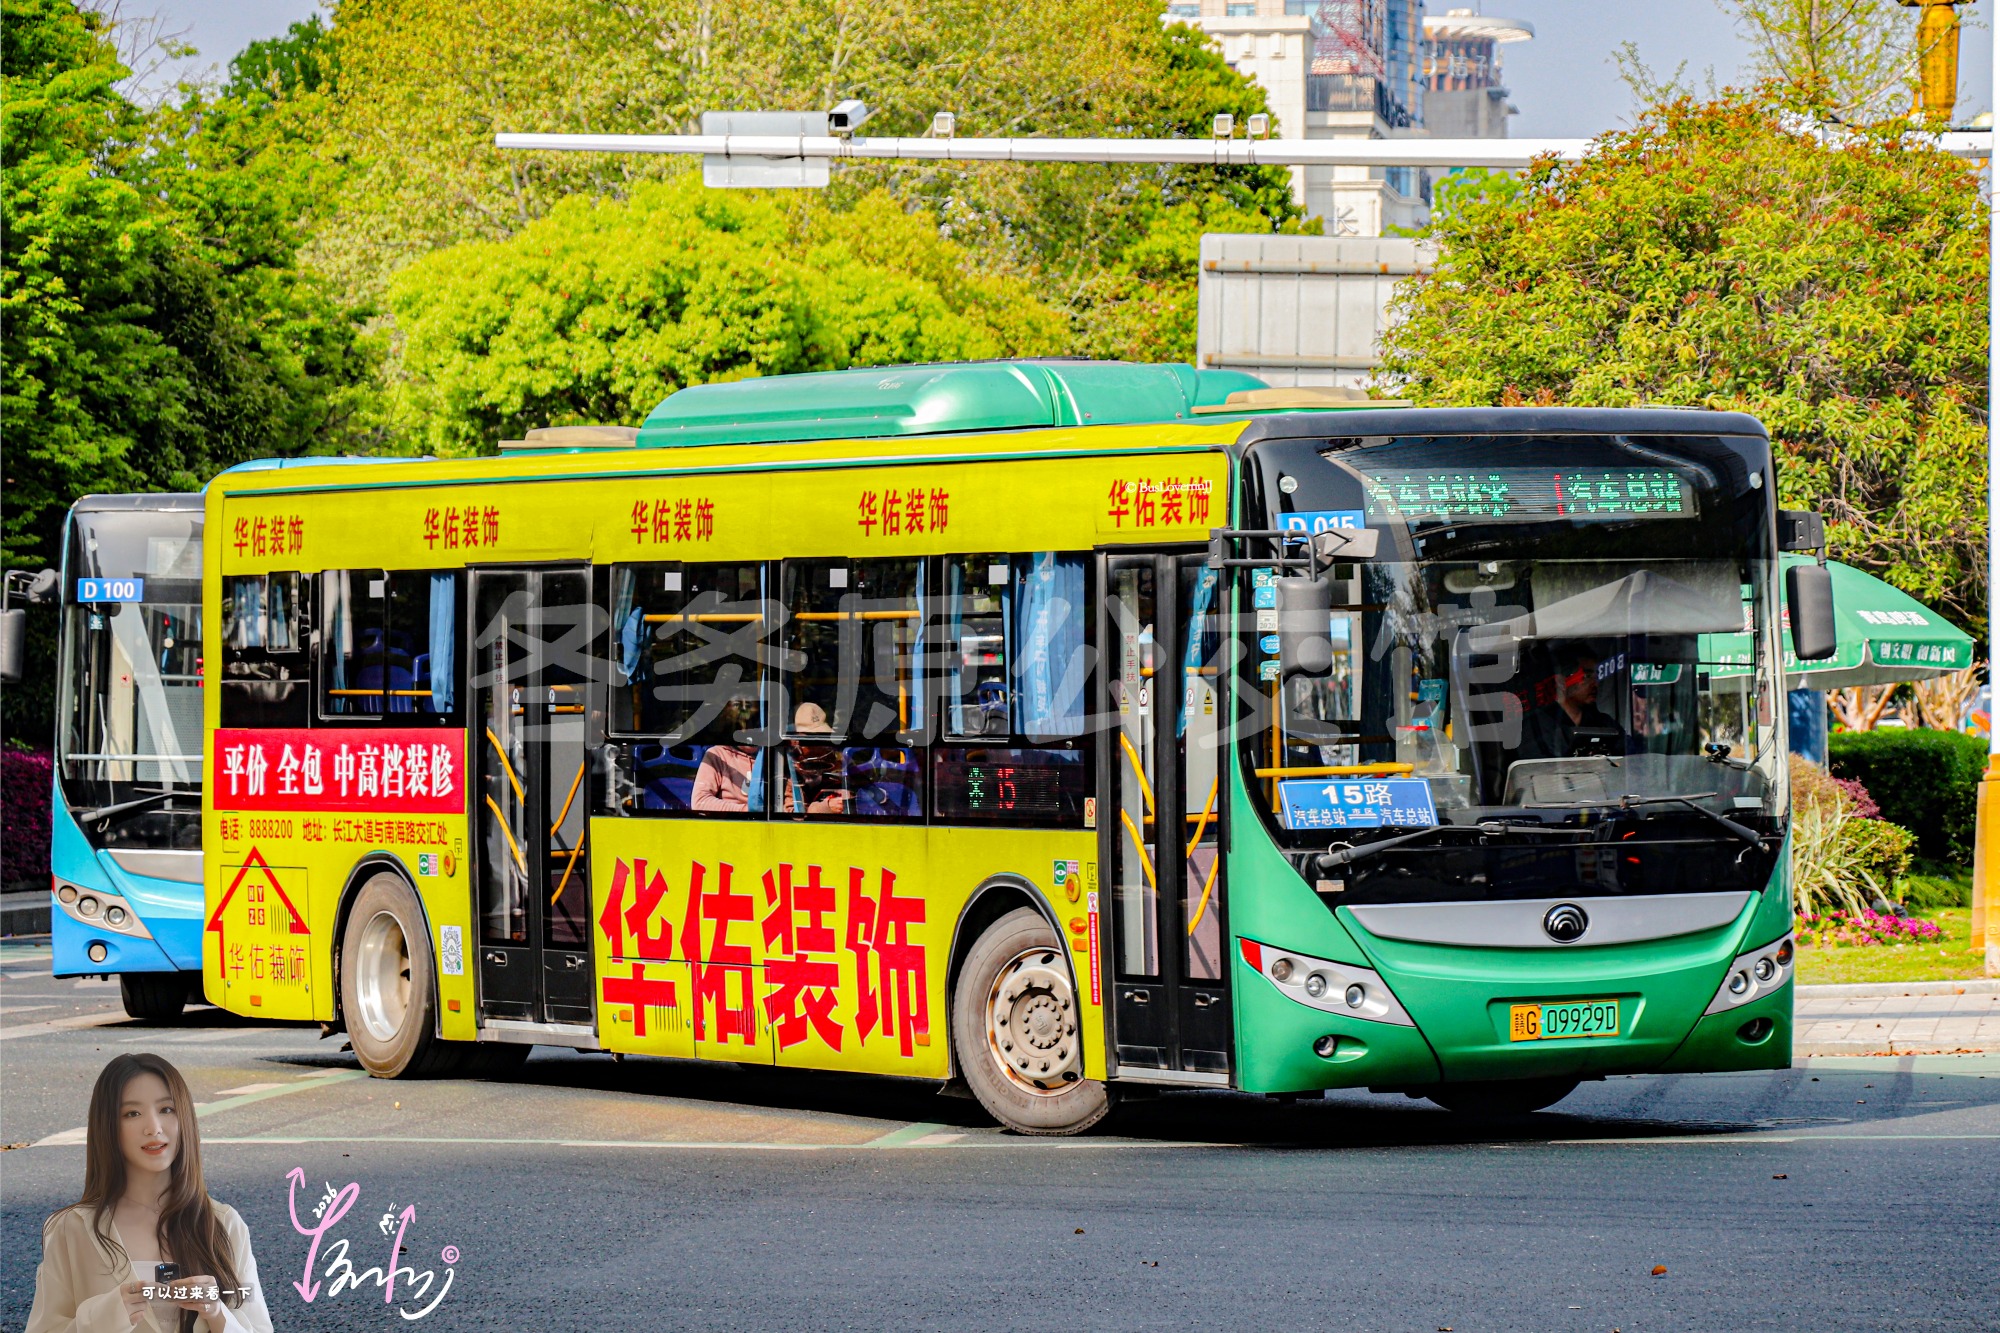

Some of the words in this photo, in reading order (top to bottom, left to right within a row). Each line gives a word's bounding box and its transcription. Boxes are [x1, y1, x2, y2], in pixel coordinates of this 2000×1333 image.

[631, 498, 714, 544] 华佑装饰
[858, 487, 949, 537] 华佑装饰
[1108, 476, 1209, 528] 华佑装饰
[233, 515, 304, 557] 华佑装饰
[424, 505, 499, 550] 华佑装饰
[84, 582, 97, 599] D
[103, 581, 135, 599] 100
[1126, 635, 1136, 682] 禁止手扶
[223, 744, 268, 796] 平价
[277, 744, 324, 796] 全包
[334, 744, 454, 798] 中高档装修
[1293, 808, 1347, 826] 汽车总站
[1380, 807, 1432, 826] 汽车总站
[1322, 783, 1393, 806] 15路
[249, 819, 293, 840] 8888200
[333, 819, 448, 846] 长江大道与南海路交汇处
[228, 944, 304, 981] 华佑装饰
[599, 857, 930, 1058] 华佑装饰
